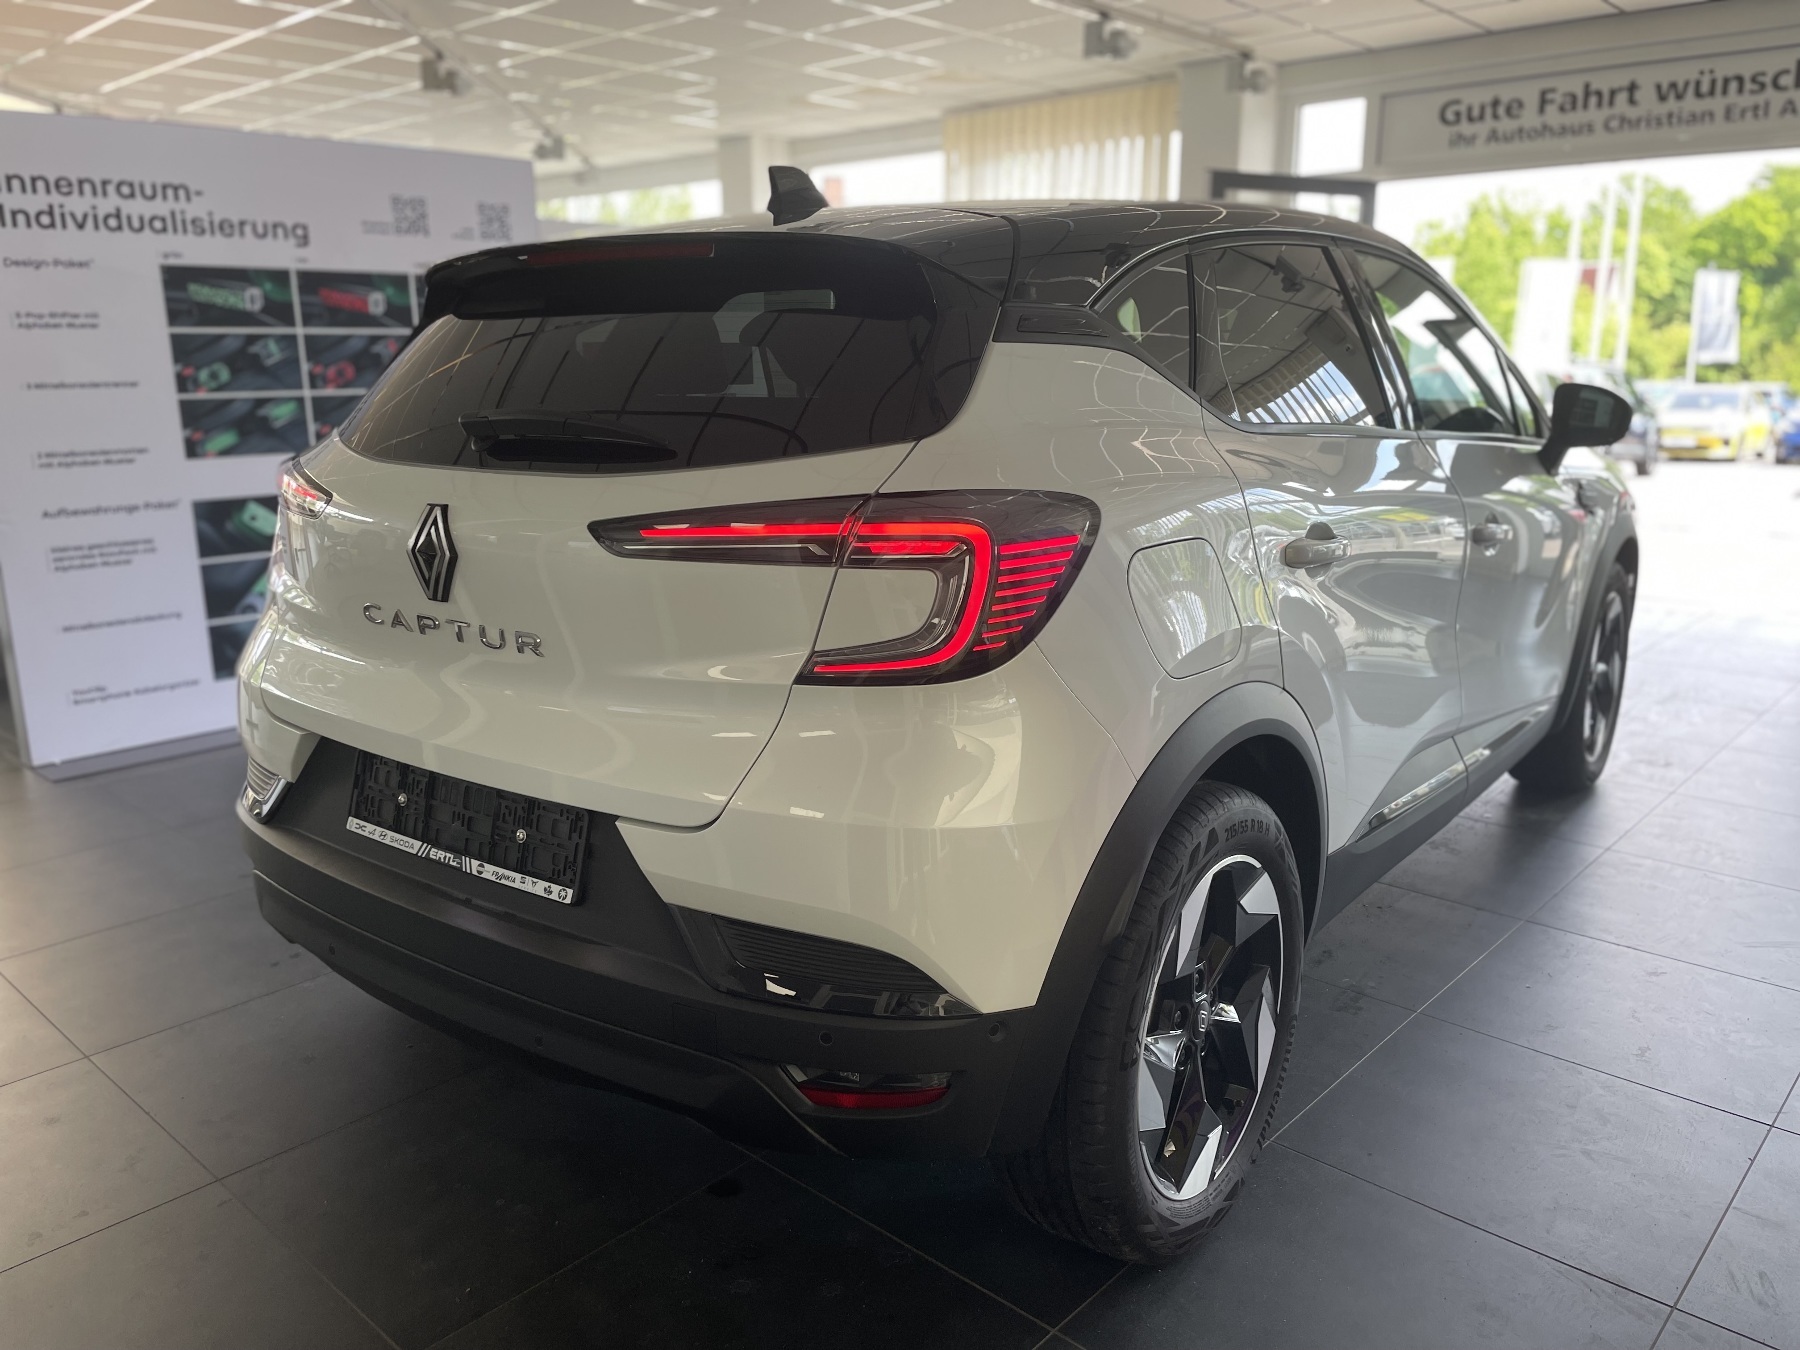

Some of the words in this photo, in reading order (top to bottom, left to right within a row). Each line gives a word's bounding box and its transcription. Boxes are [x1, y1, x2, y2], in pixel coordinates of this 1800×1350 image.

[1439, 96, 1524, 126] Gute
[1538, 79, 1641, 115] Fahrt
[1485, 119, 1595, 145] Autohaus
[1603, 106, 1715, 134] Christian
[1724, 98, 1771, 123] Ertl
[0, 172, 204, 204] nnenraum-
[0, 201, 311, 248] Individualisierung
[363, 602, 545, 658] CAPTUR
[1224, 819, 1249, 843] 215/55
[1250, 818, 1256, 833] R
[430, 847, 460, 867] ERTL
